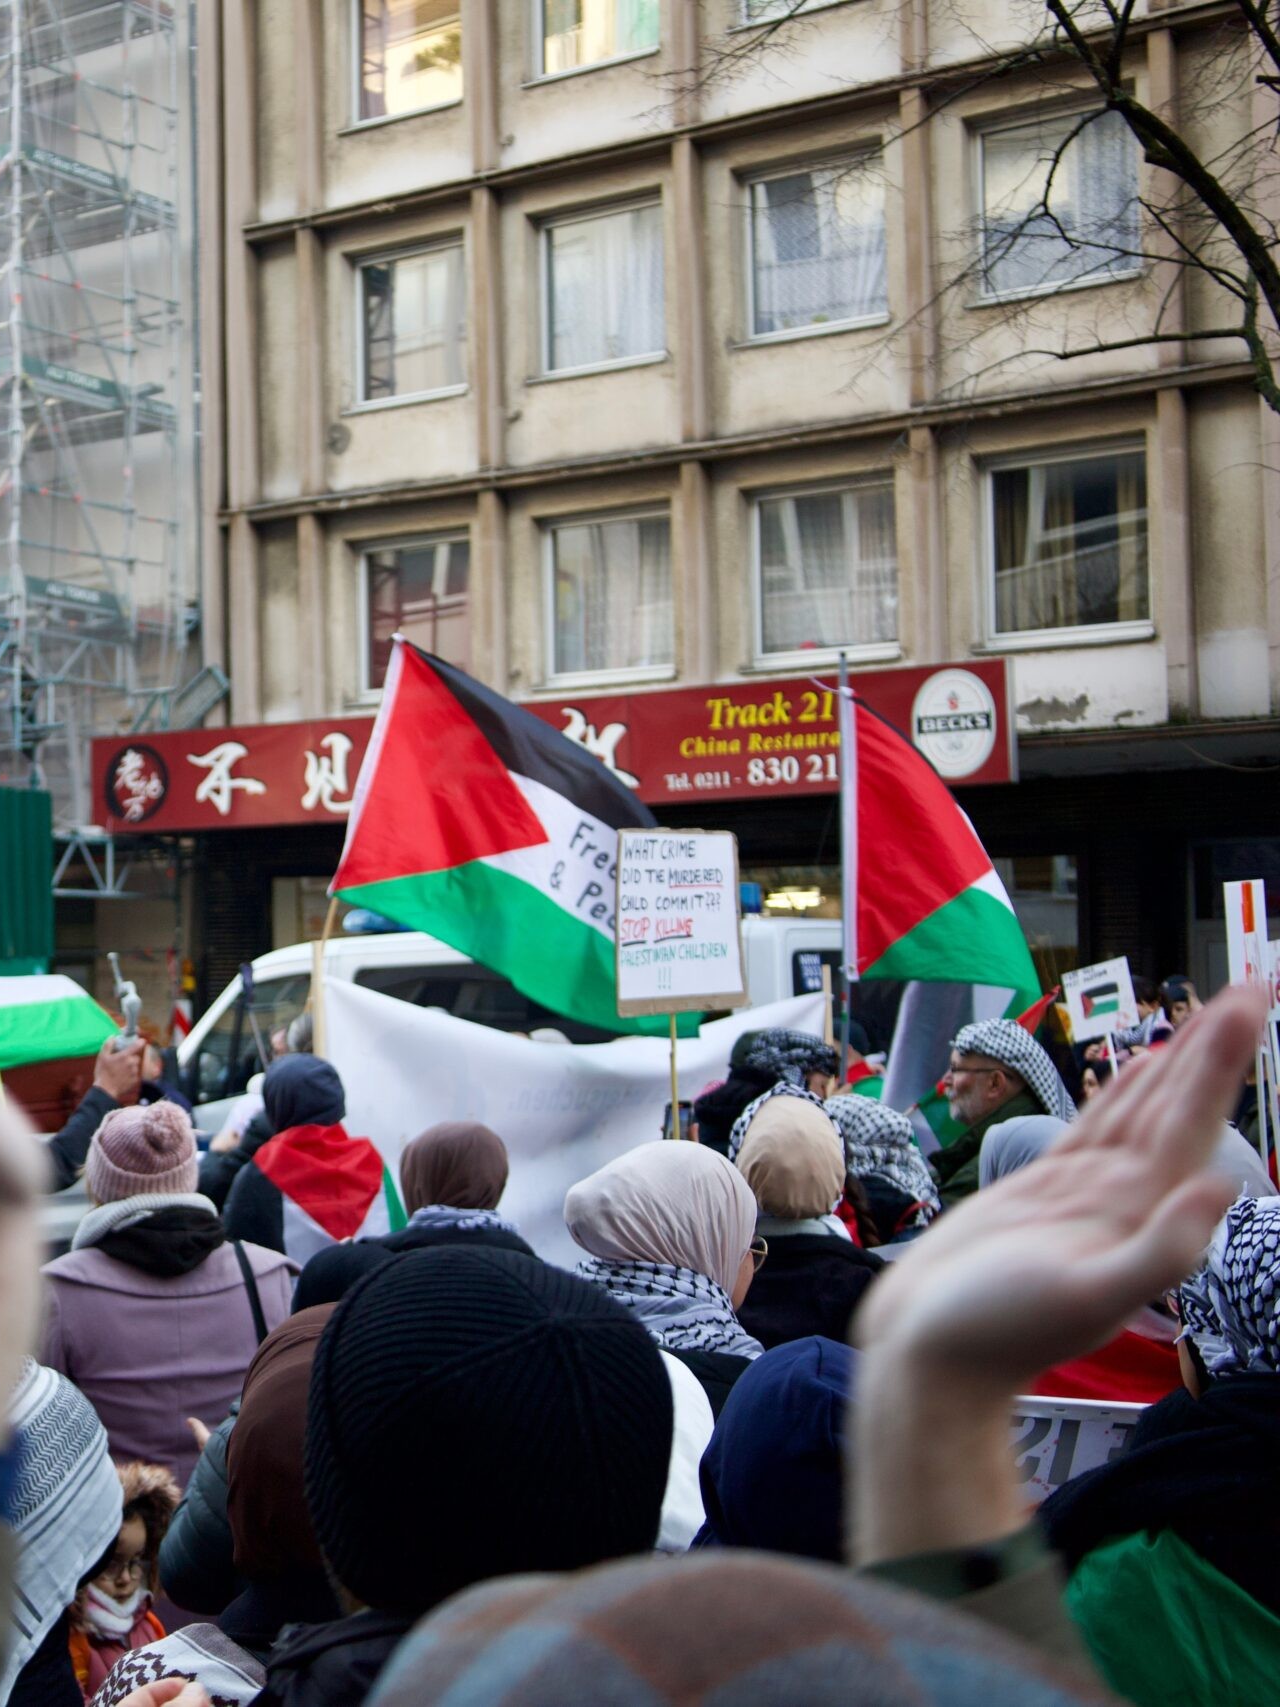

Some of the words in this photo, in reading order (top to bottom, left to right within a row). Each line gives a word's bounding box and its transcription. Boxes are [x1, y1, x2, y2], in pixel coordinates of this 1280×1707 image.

[706, 691, 792, 730] Track
[798, 691, 833, 723] 21
[679, 735, 741, 758] China
[747, 730, 840, 753] Restaura
[747, 755, 800, 786] 830
[805, 753, 839, 783] 21
[624, 839, 658, 860] WHAT
[661, 839, 696, 860] CRIME
[622, 867, 641, 885] DID
[621, 894, 648, 911] CHILD
[621, 916, 650, 940] STOP
[655, 917, 693, 939] KILLING
[678, 943, 728, 961] CHILDREN
